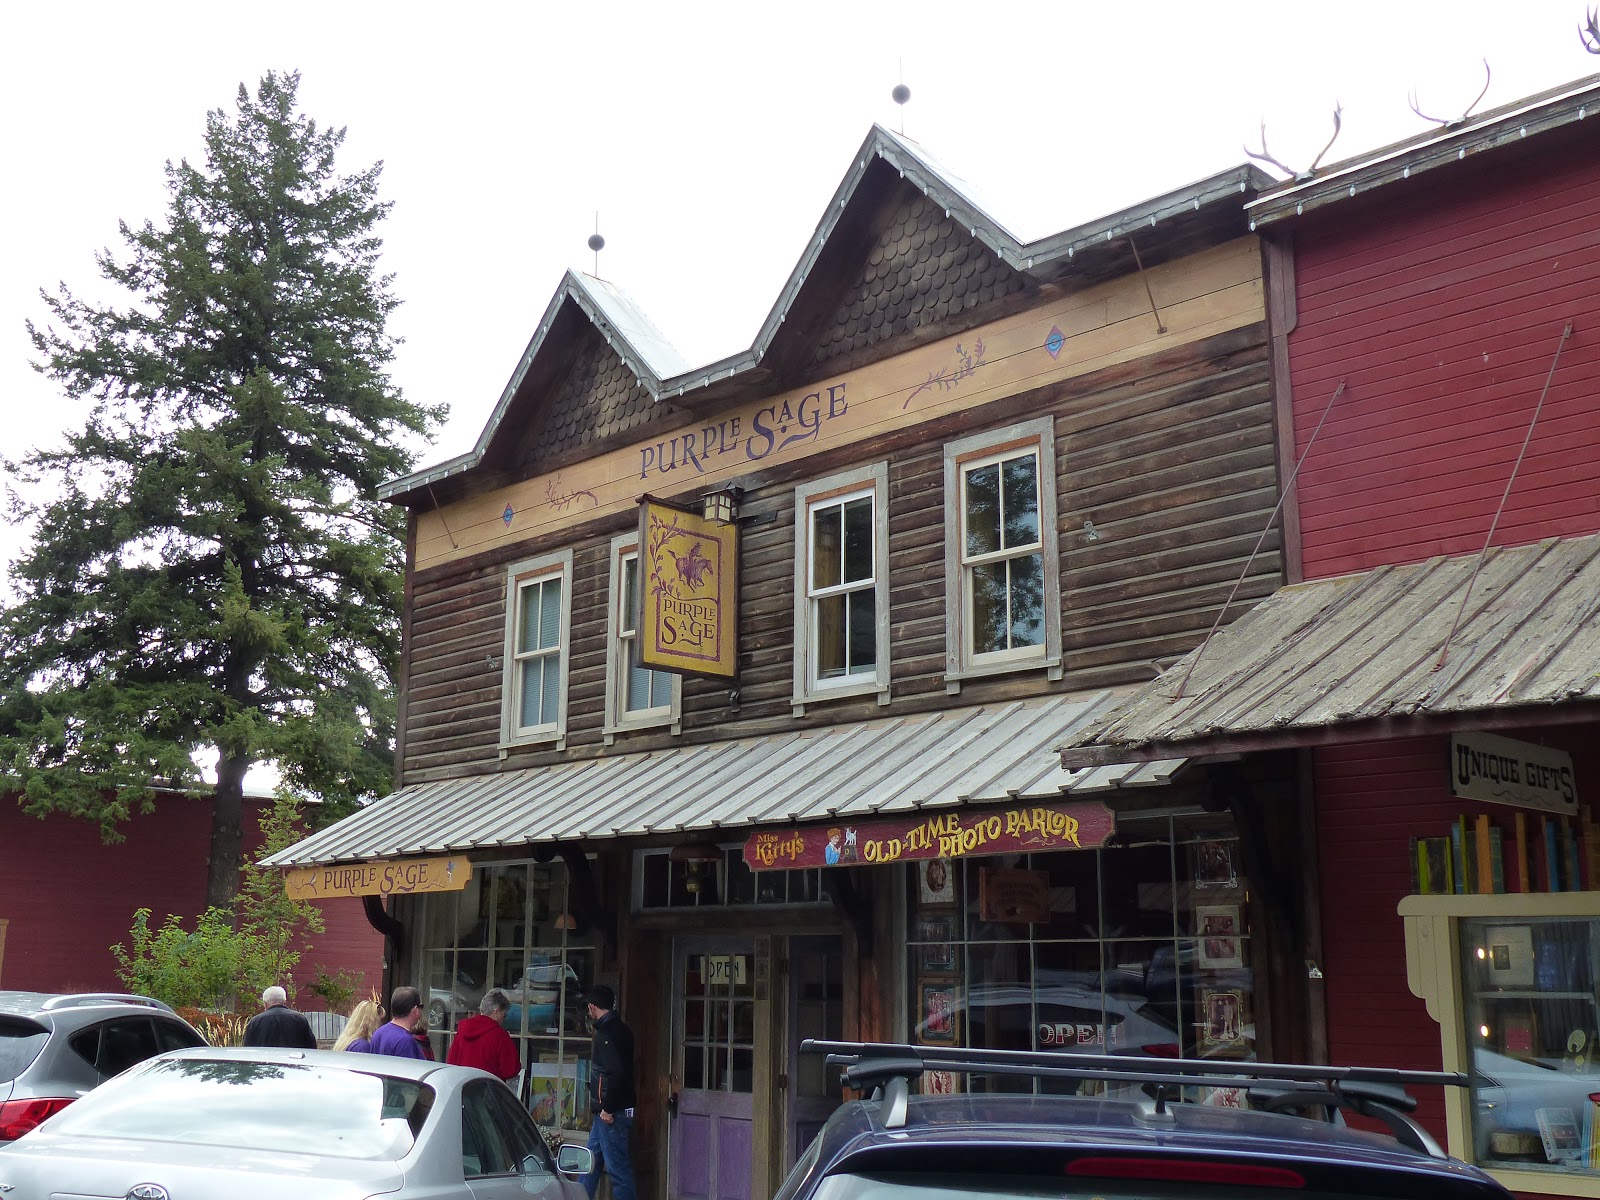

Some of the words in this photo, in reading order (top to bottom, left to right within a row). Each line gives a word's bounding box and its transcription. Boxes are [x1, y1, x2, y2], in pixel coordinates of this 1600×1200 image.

[639, 416, 742, 480] PURPLE
[745, 382, 849, 461] SAGE
[663, 598, 716, 621] PURPLE
[661, 616, 716, 647] SAGE
[1456, 743, 1521, 786] UNIQUE
[1525, 762, 1575, 804] GIFTS
[755, 831, 805, 866] Kitty's
[757, 834, 779, 843] Miss
[938, 815, 1003, 858] PHOTO
[1005, 807, 1083, 850] PARLOR
[323, 867, 377, 895] PURPLE
[379, 863, 429, 894] SAGE
[1039, 1024, 1118, 1046] OPEN
